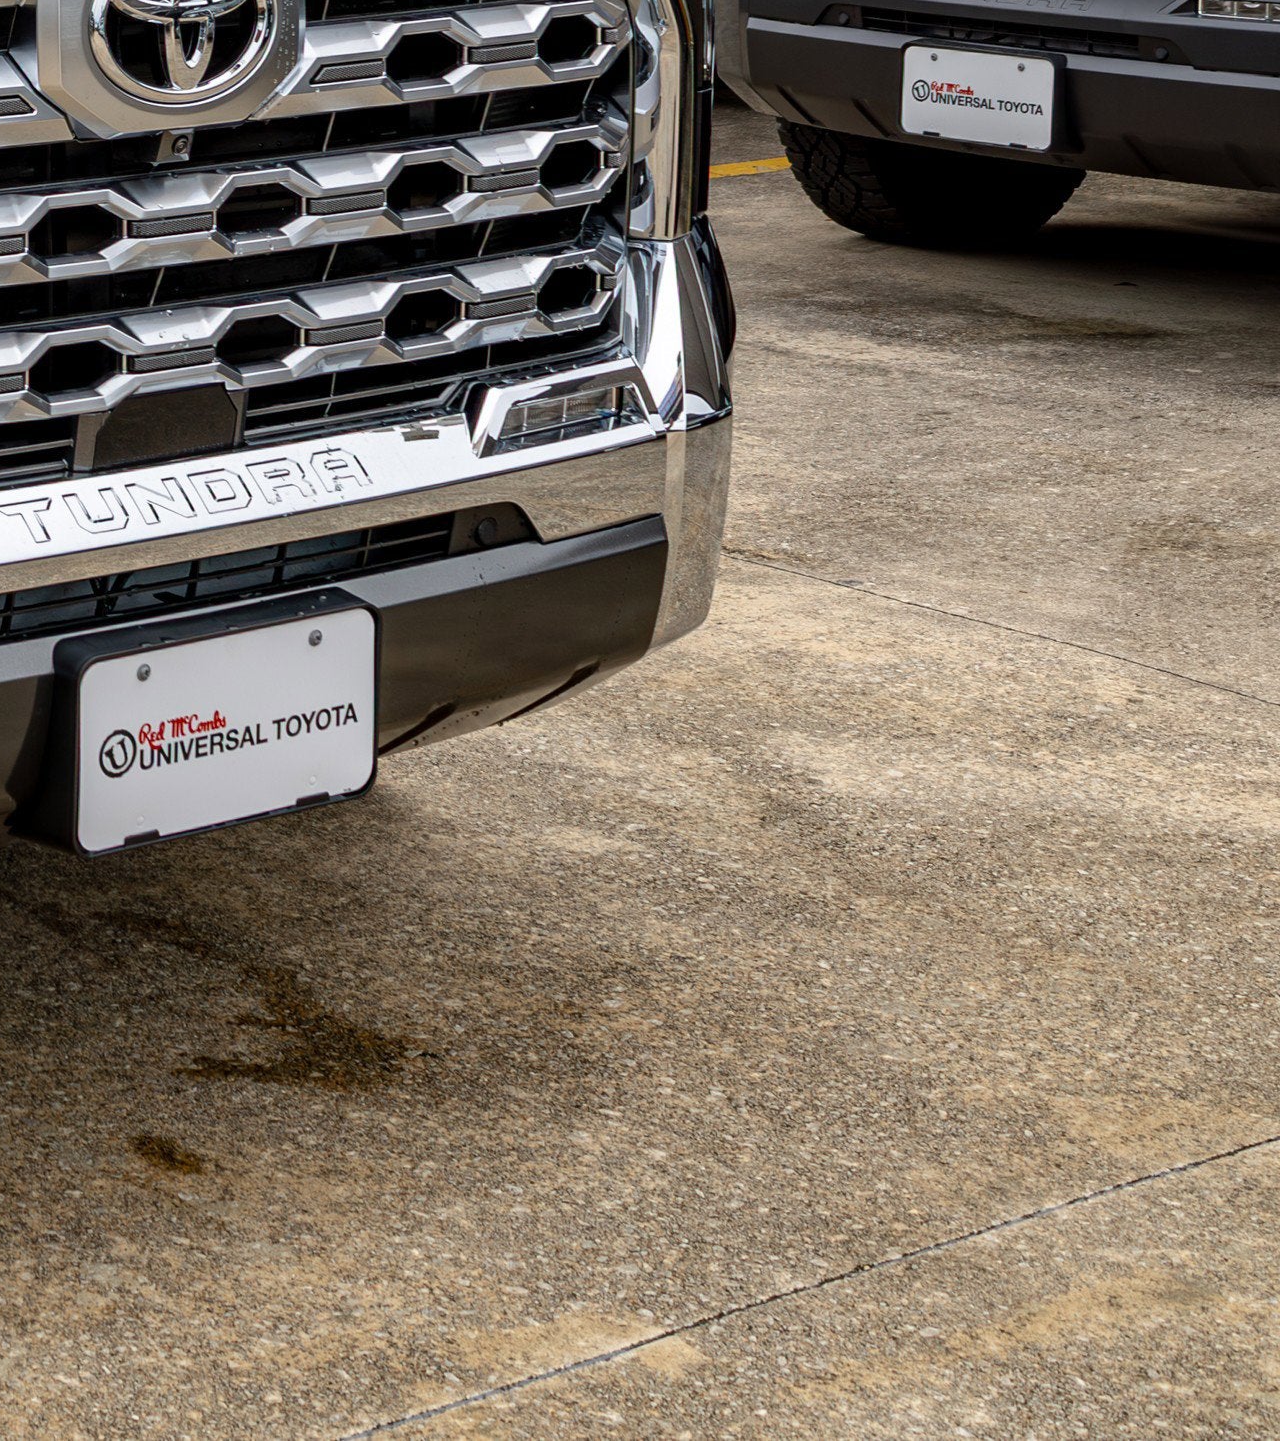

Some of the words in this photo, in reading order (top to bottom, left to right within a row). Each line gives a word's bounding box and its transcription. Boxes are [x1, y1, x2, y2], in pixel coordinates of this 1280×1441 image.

[930, 92, 995, 110] UNIVERSAL
[997, 99, 1044, 116] TOYOTA
[138, 723, 165, 751] Red
[167, 710, 227, 738] McCombs
[140, 725, 269, 770] UNIVERSAL
[272, 702, 359, 740] TOYOTA
